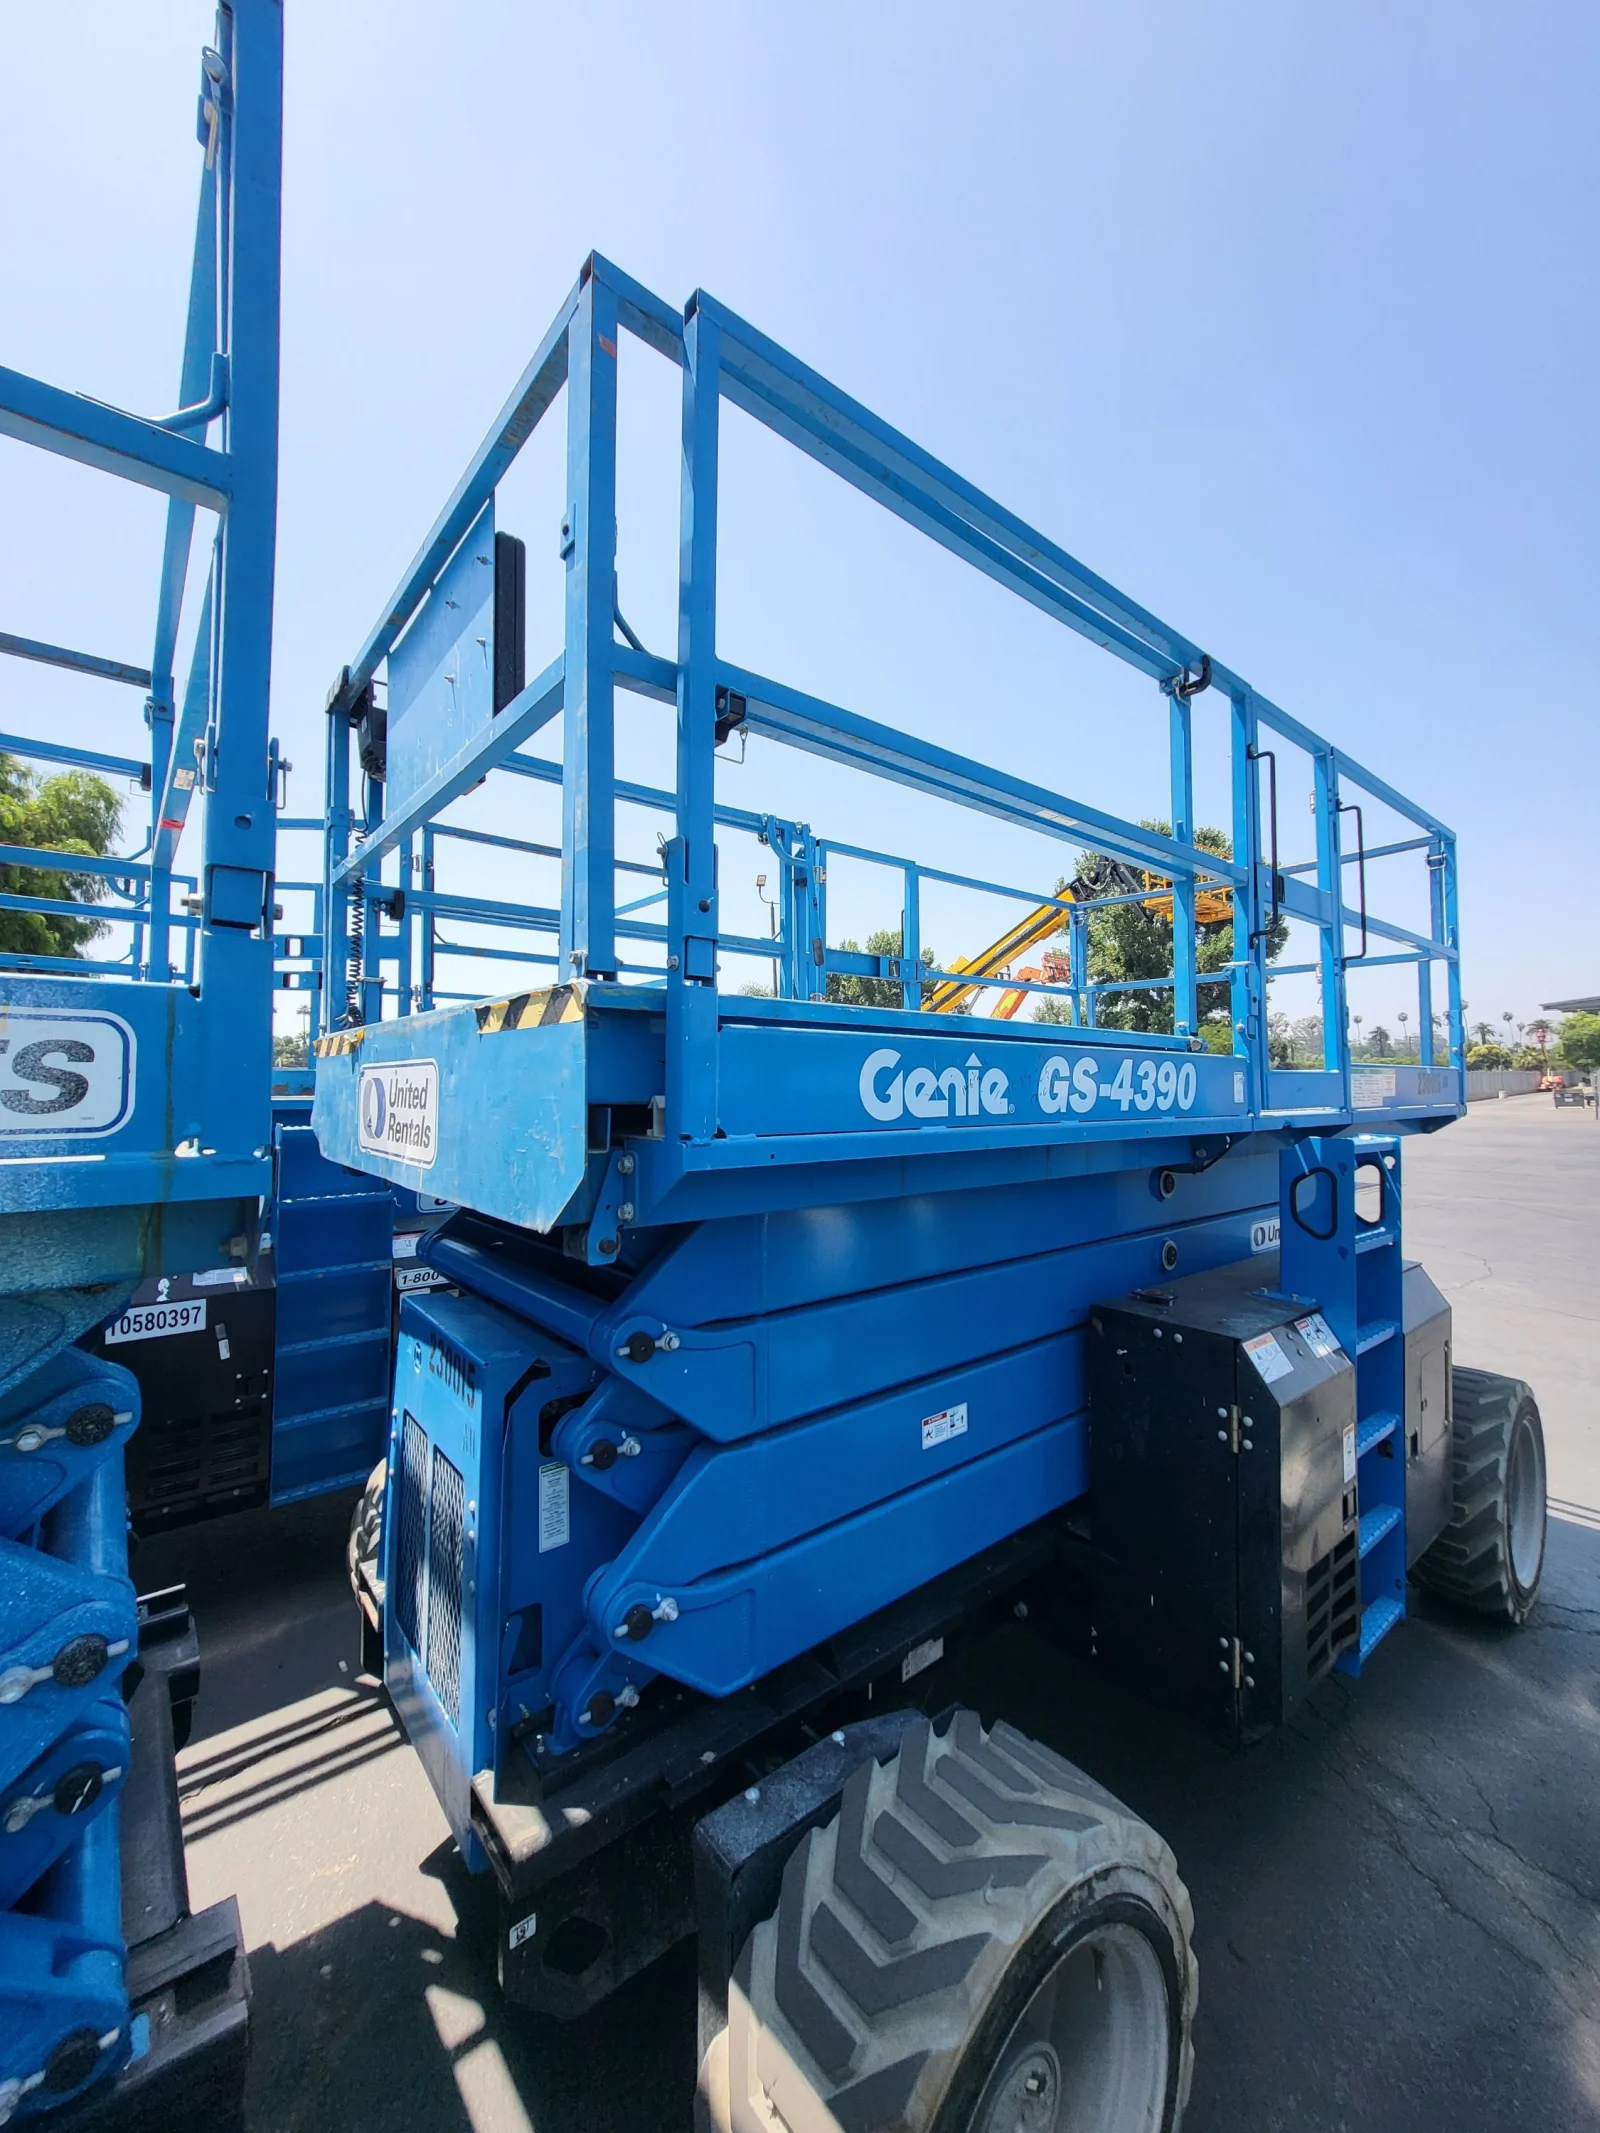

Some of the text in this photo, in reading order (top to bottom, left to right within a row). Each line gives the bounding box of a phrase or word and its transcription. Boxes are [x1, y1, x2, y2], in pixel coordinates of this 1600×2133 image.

[0, 1039, 95, 1114] S
[388, 1077, 429, 1110] United
[859, 1048, 1009, 1121] Genie
[1038, 1056, 1197, 1114] GS-4390
[387, 1112, 431, 1148] Rentals
